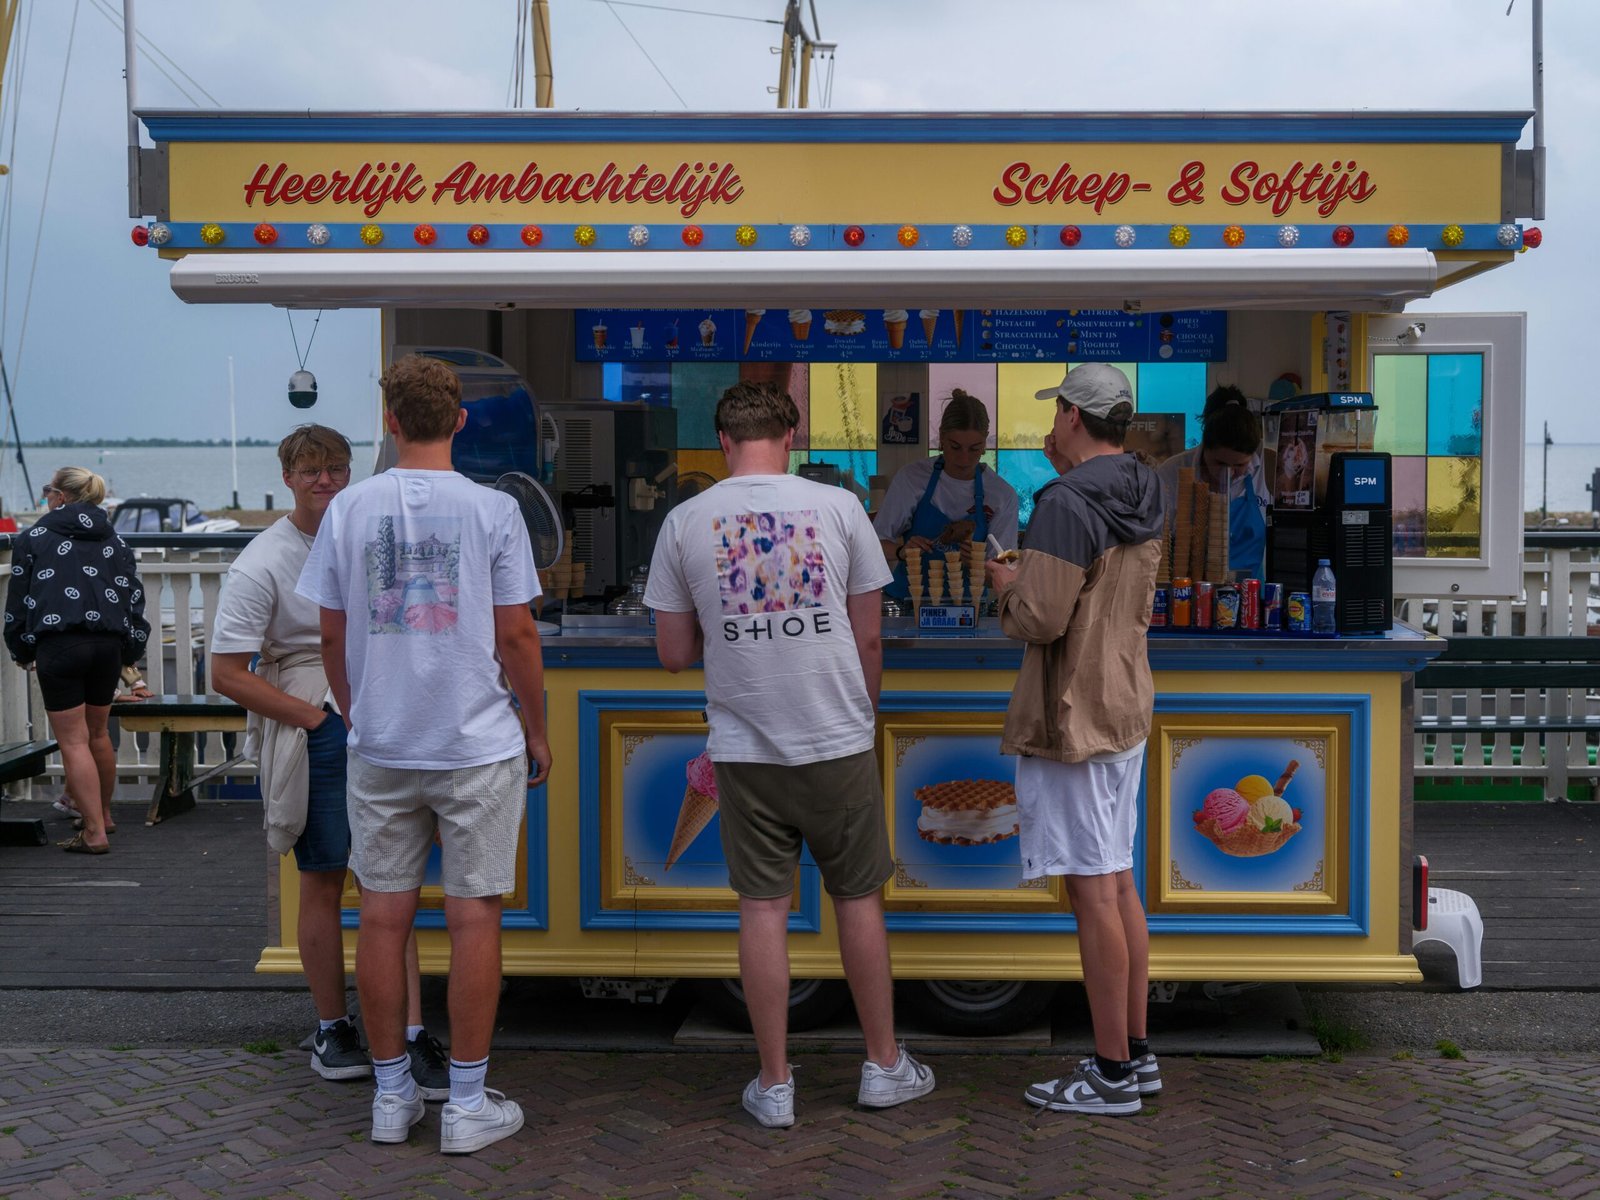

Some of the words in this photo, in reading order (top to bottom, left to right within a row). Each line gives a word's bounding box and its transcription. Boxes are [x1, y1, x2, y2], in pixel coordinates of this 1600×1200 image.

[243, 160, 427, 219] Heerlijk
[432, 159, 745, 220] Ambachtelijk
[992, 161, 1152, 216] Schep-
[1166, 160, 1206, 204] &
[1219, 160, 1377, 217] Softijs
[215, 272, 260, 285] BRUSTOR
[995, 319, 1036, 327] PISTACHE
[994, 330, 1059, 338] STRACCIATELLA
[1080, 330, 1104, 338] MINT
[1340, 396, 1363, 404] SPM
[1126, 421, 1157, 432] FFIE
[1354, 477, 1377, 485] SPM
[1173, 586, 1192, 598] FANT
[921, 608, 947, 617] PINNEN
[932, 617, 957, 626] GRAAG
